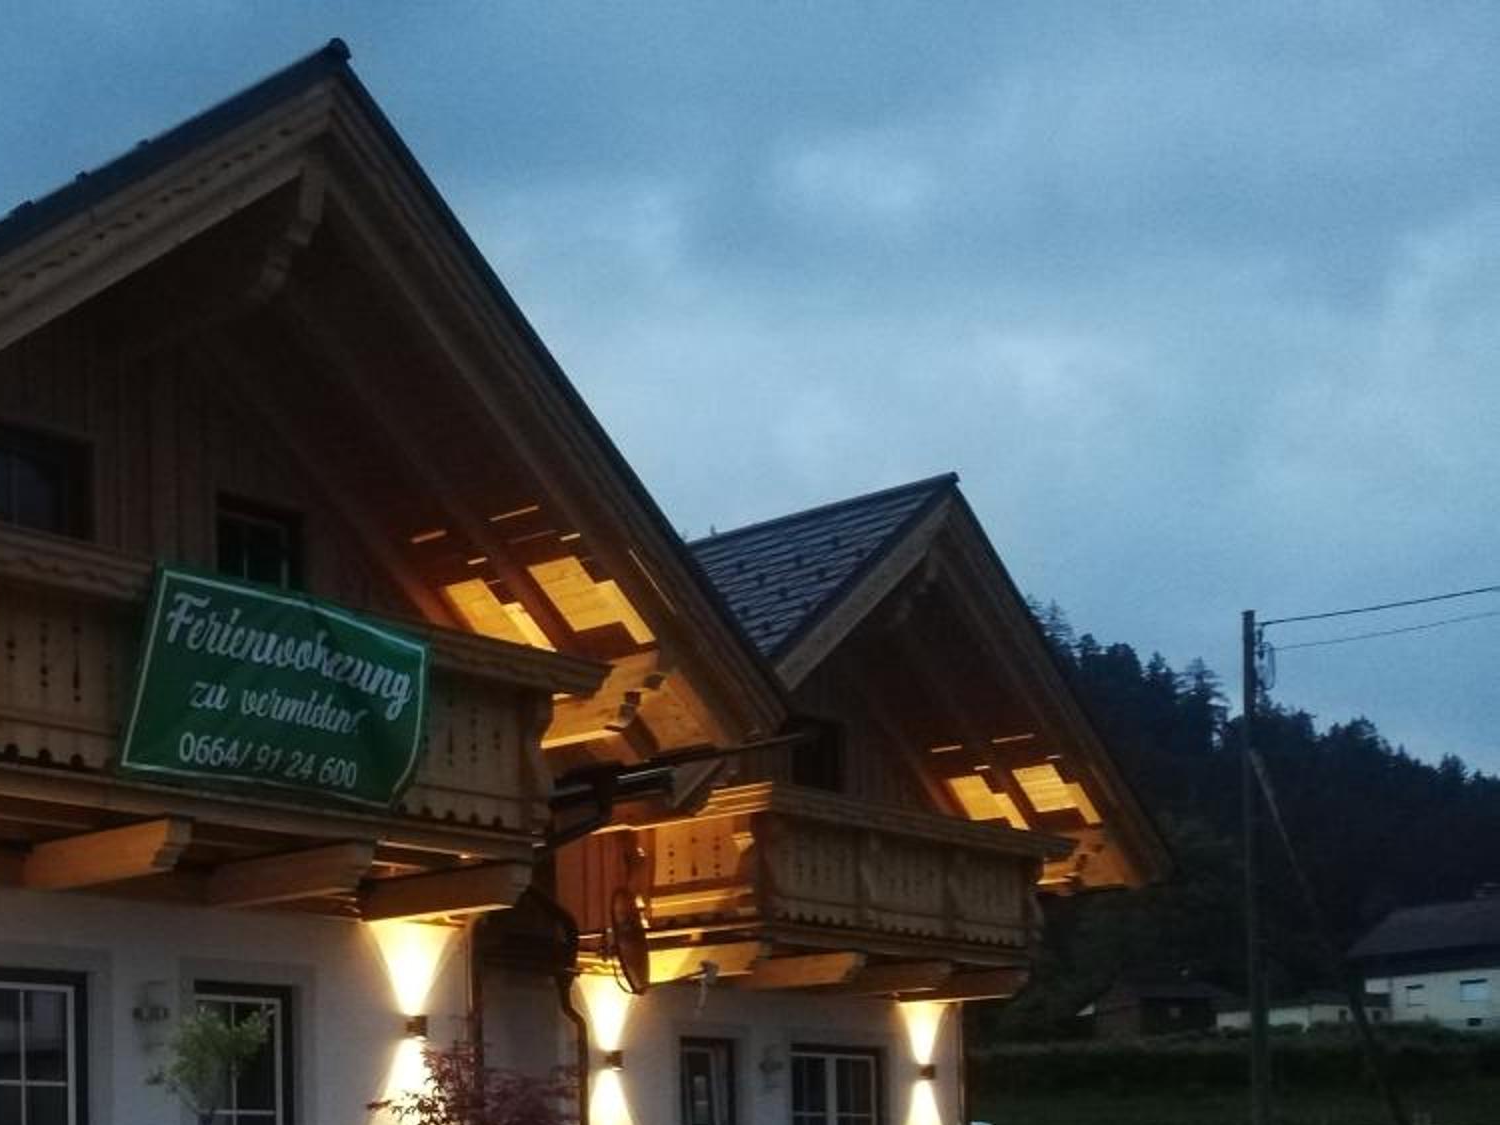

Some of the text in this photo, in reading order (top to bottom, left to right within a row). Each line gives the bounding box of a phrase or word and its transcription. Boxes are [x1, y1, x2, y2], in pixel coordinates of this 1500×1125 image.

[190, 681, 228, 711] zu
[284, 751, 316, 780] 24
[318, 756, 357, 789] 600
